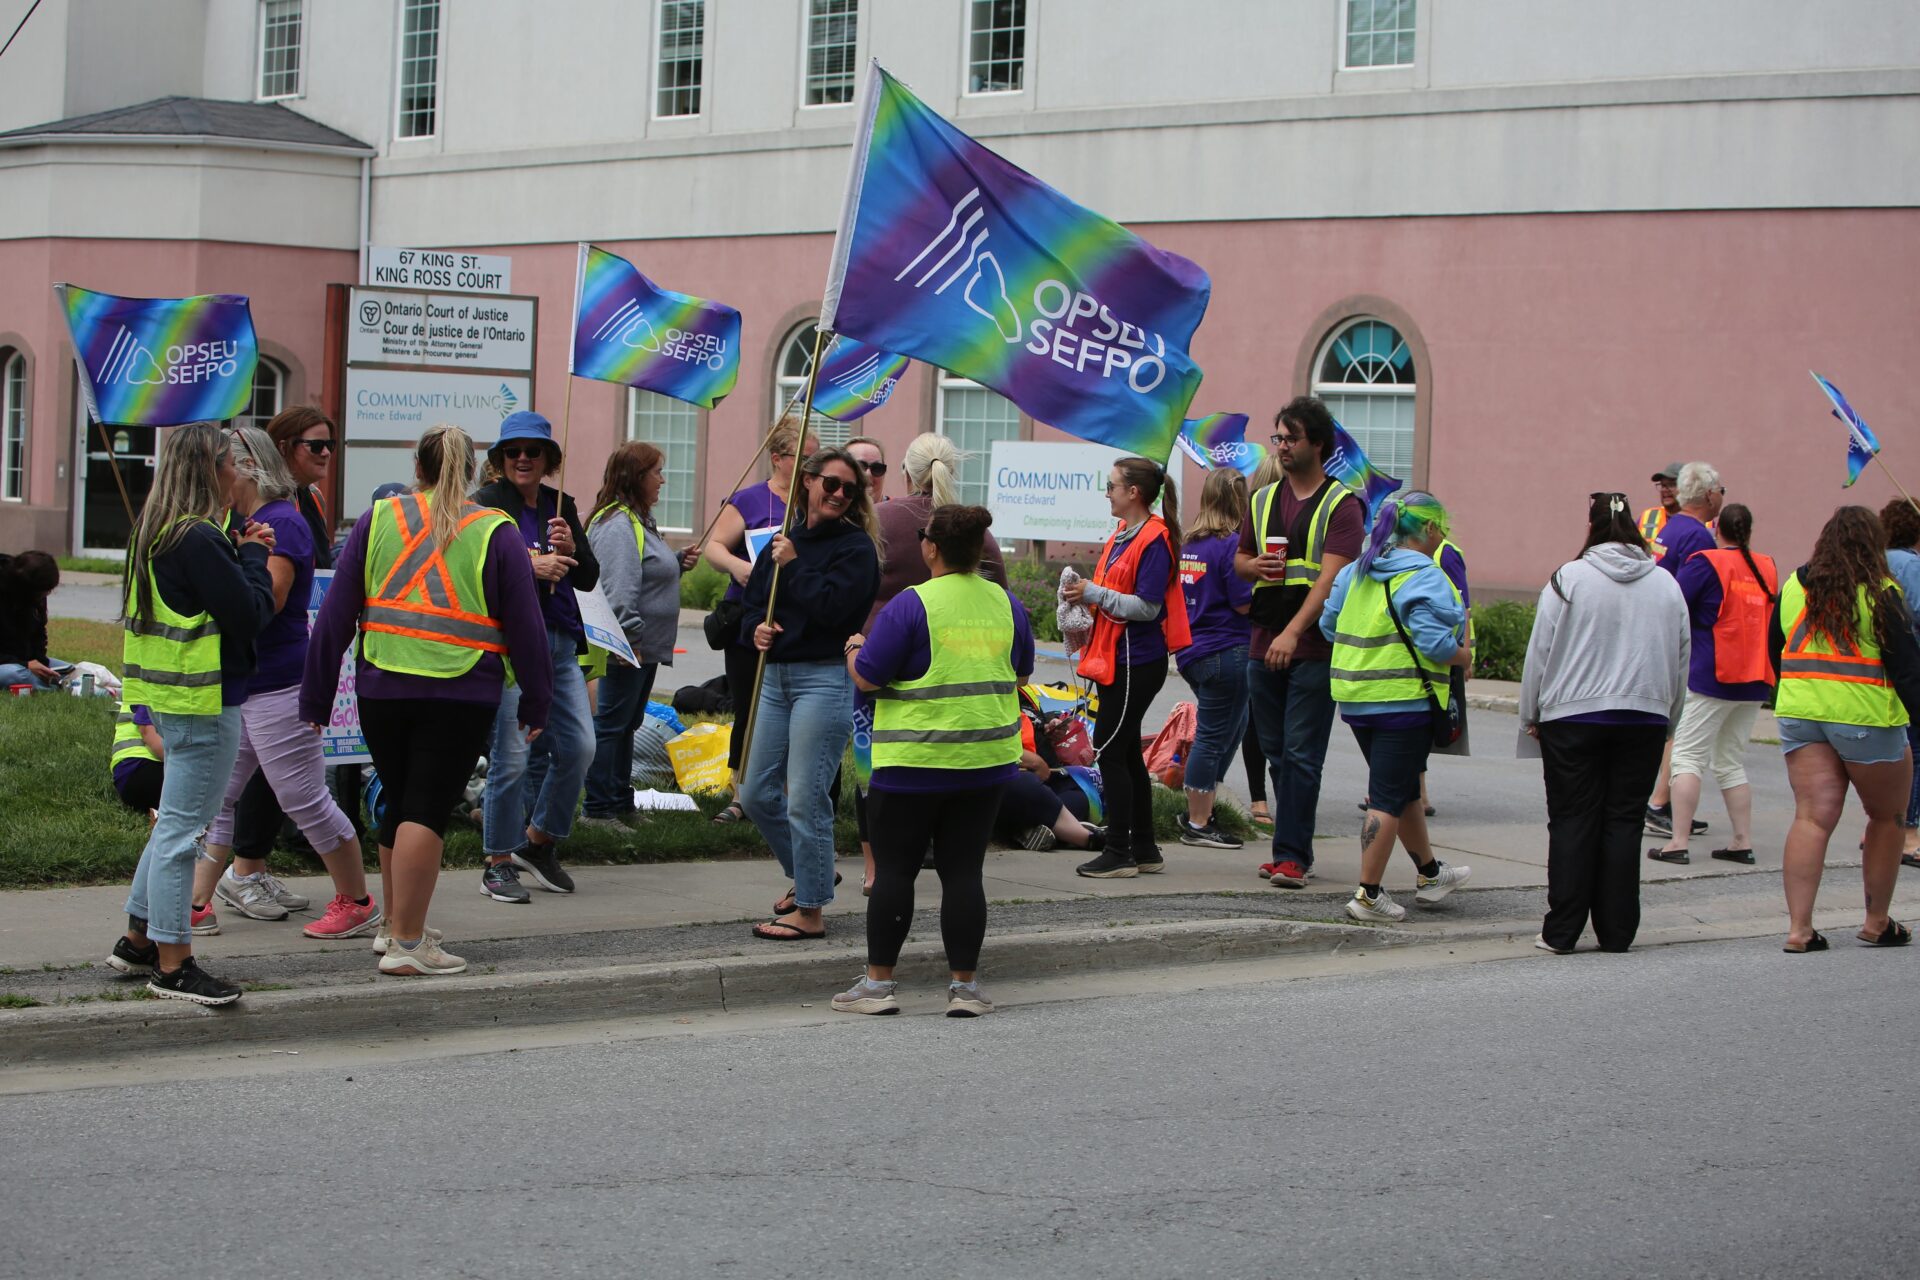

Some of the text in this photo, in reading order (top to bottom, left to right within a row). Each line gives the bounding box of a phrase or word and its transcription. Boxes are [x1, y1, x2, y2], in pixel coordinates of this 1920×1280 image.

[400, 251, 481, 270] 67 KING ST.
[376, 266, 502, 289] KING ROSS COURT
[384, 301, 509, 322] Ontario Court of Justice
[383, 320, 526, 342] Cour de justice de l'Ontario
[665, 328, 726, 354] OPSEU
[166, 340, 238, 365] OPSEU
[382, 337, 483, 350] Ministry of the Attorney General
[412, 348, 421, 356] du
[423, 348, 453, 358] Procureur
[661, 341, 724, 371] SEFPO
[1025, 318, 1166, 394] SEFPO
[167, 359, 238, 385] SEFPO
[357, 389, 501, 409] COMMUNITY LIVING
[356, 410, 423, 422] Prince Edward
[997, 467, 1094, 491] COMMUNITY
[996, 493, 1056, 506] Prince Edward
